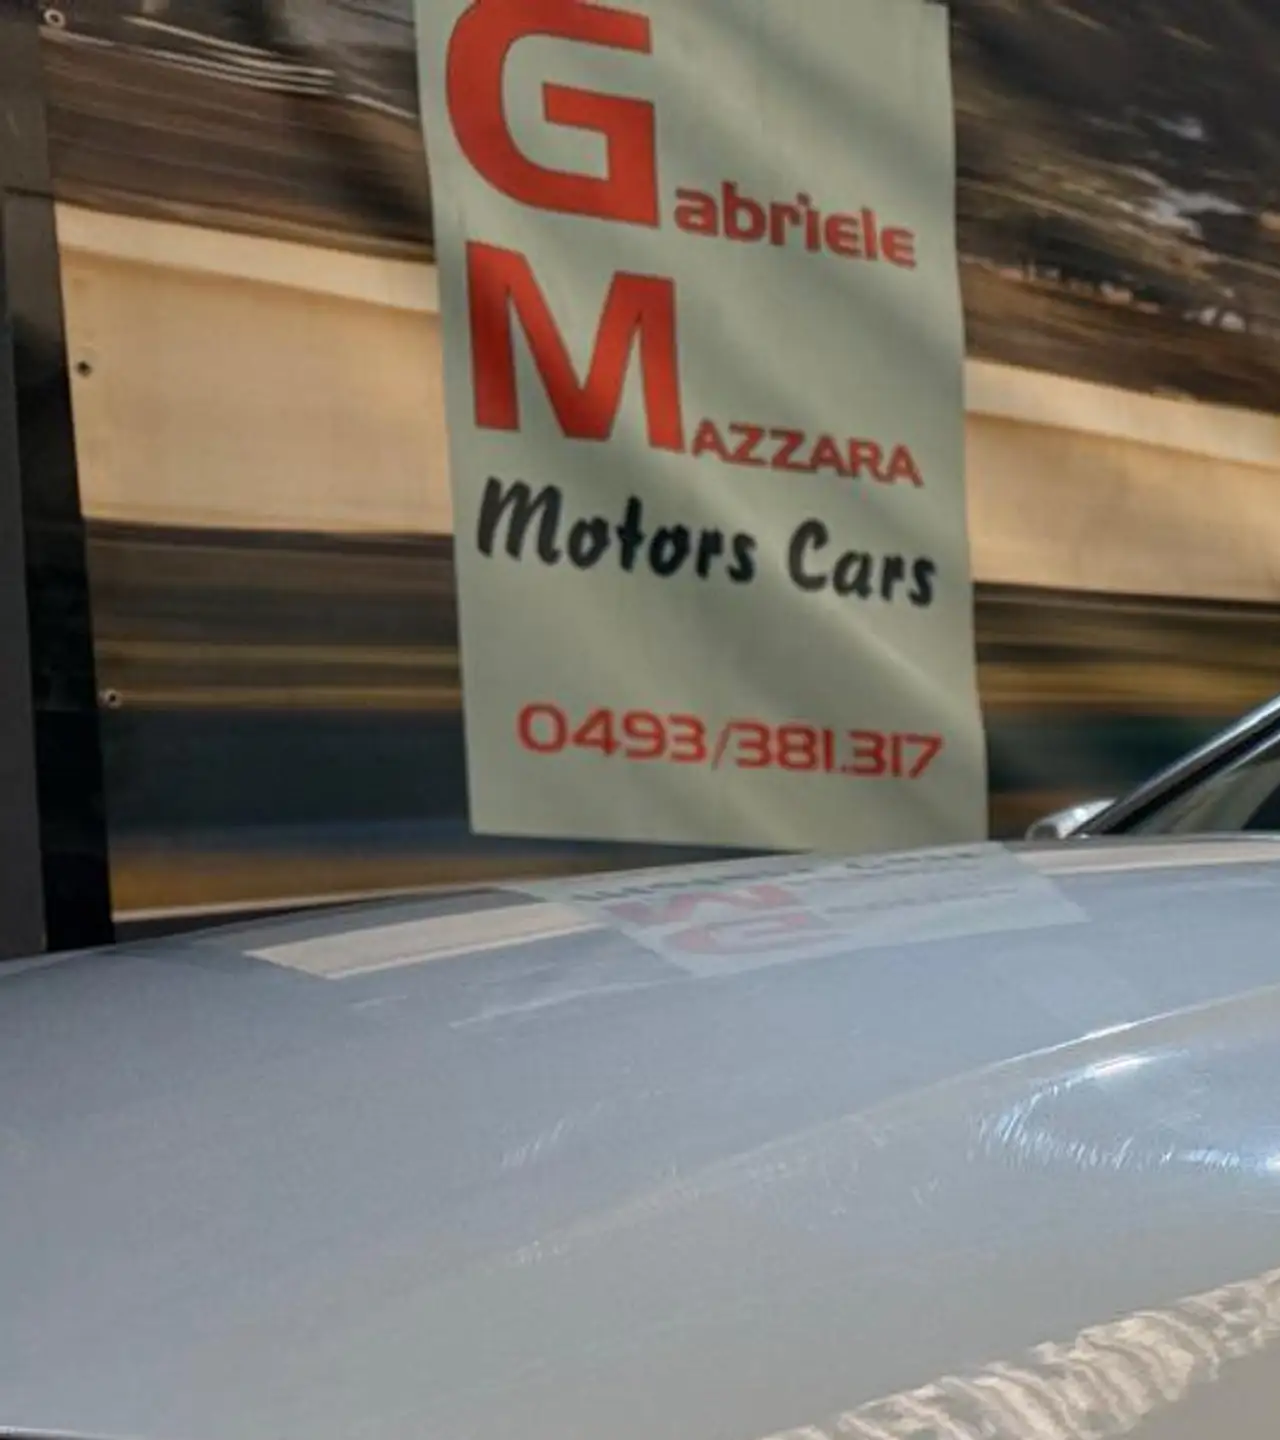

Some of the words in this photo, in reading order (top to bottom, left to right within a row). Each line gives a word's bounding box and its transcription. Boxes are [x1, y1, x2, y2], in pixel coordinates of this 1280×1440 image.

[466, 240, 923, 488] MAZZARA
[476, 475, 756, 583] Motors
[787, 518, 936, 607] Cars
[515, 703, 943, 779] 0493/381.317
